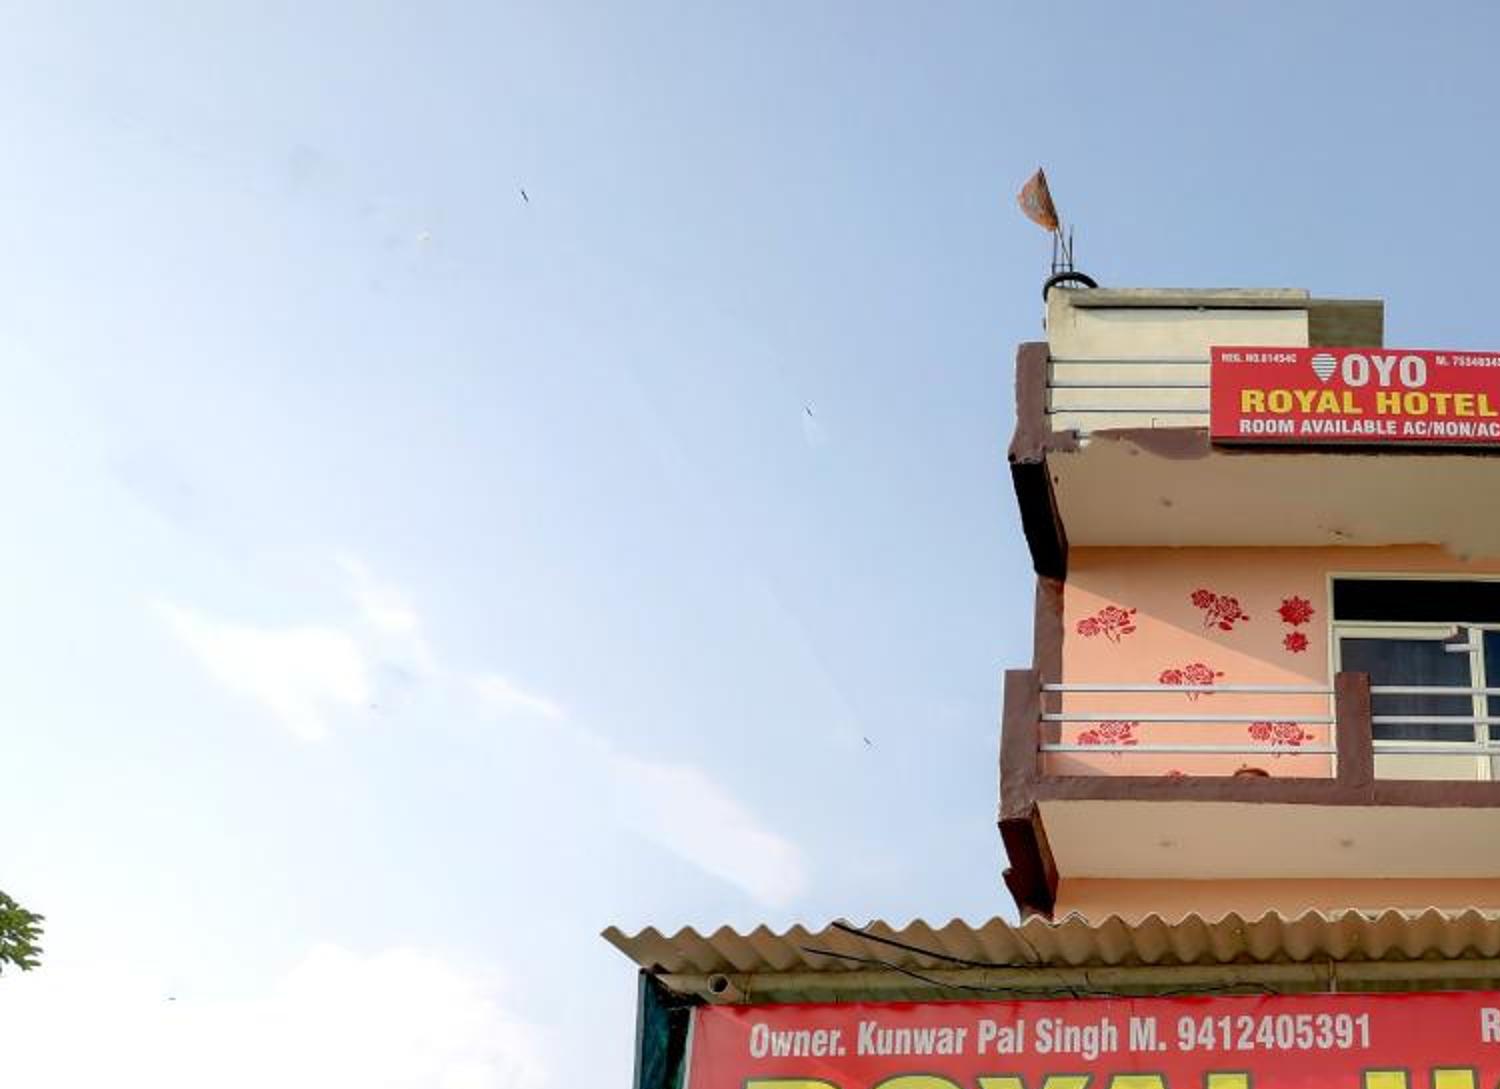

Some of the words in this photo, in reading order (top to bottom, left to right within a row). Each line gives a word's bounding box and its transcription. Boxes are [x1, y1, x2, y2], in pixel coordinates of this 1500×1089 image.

[1341, 353, 1428, 388] OYO
[1240, 388, 1363, 415] ROYAL
[1376, 390, 1500, 417] HOTEL
[1239, 419, 1295, 434] ROOM
[1300, 419, 1398, 436] AVAILABLE
[749, 1022, 846, 1059] Owner.
[857, 1019, 967, 1056] Kunwar
[977, 1018, 1025, 1055] Pal
[1034, 1015, 1119, 1062] Singh
[1128, 1017, 1167, 1052] M.
[1176, 1012, 1372, 1051] 9412405391
